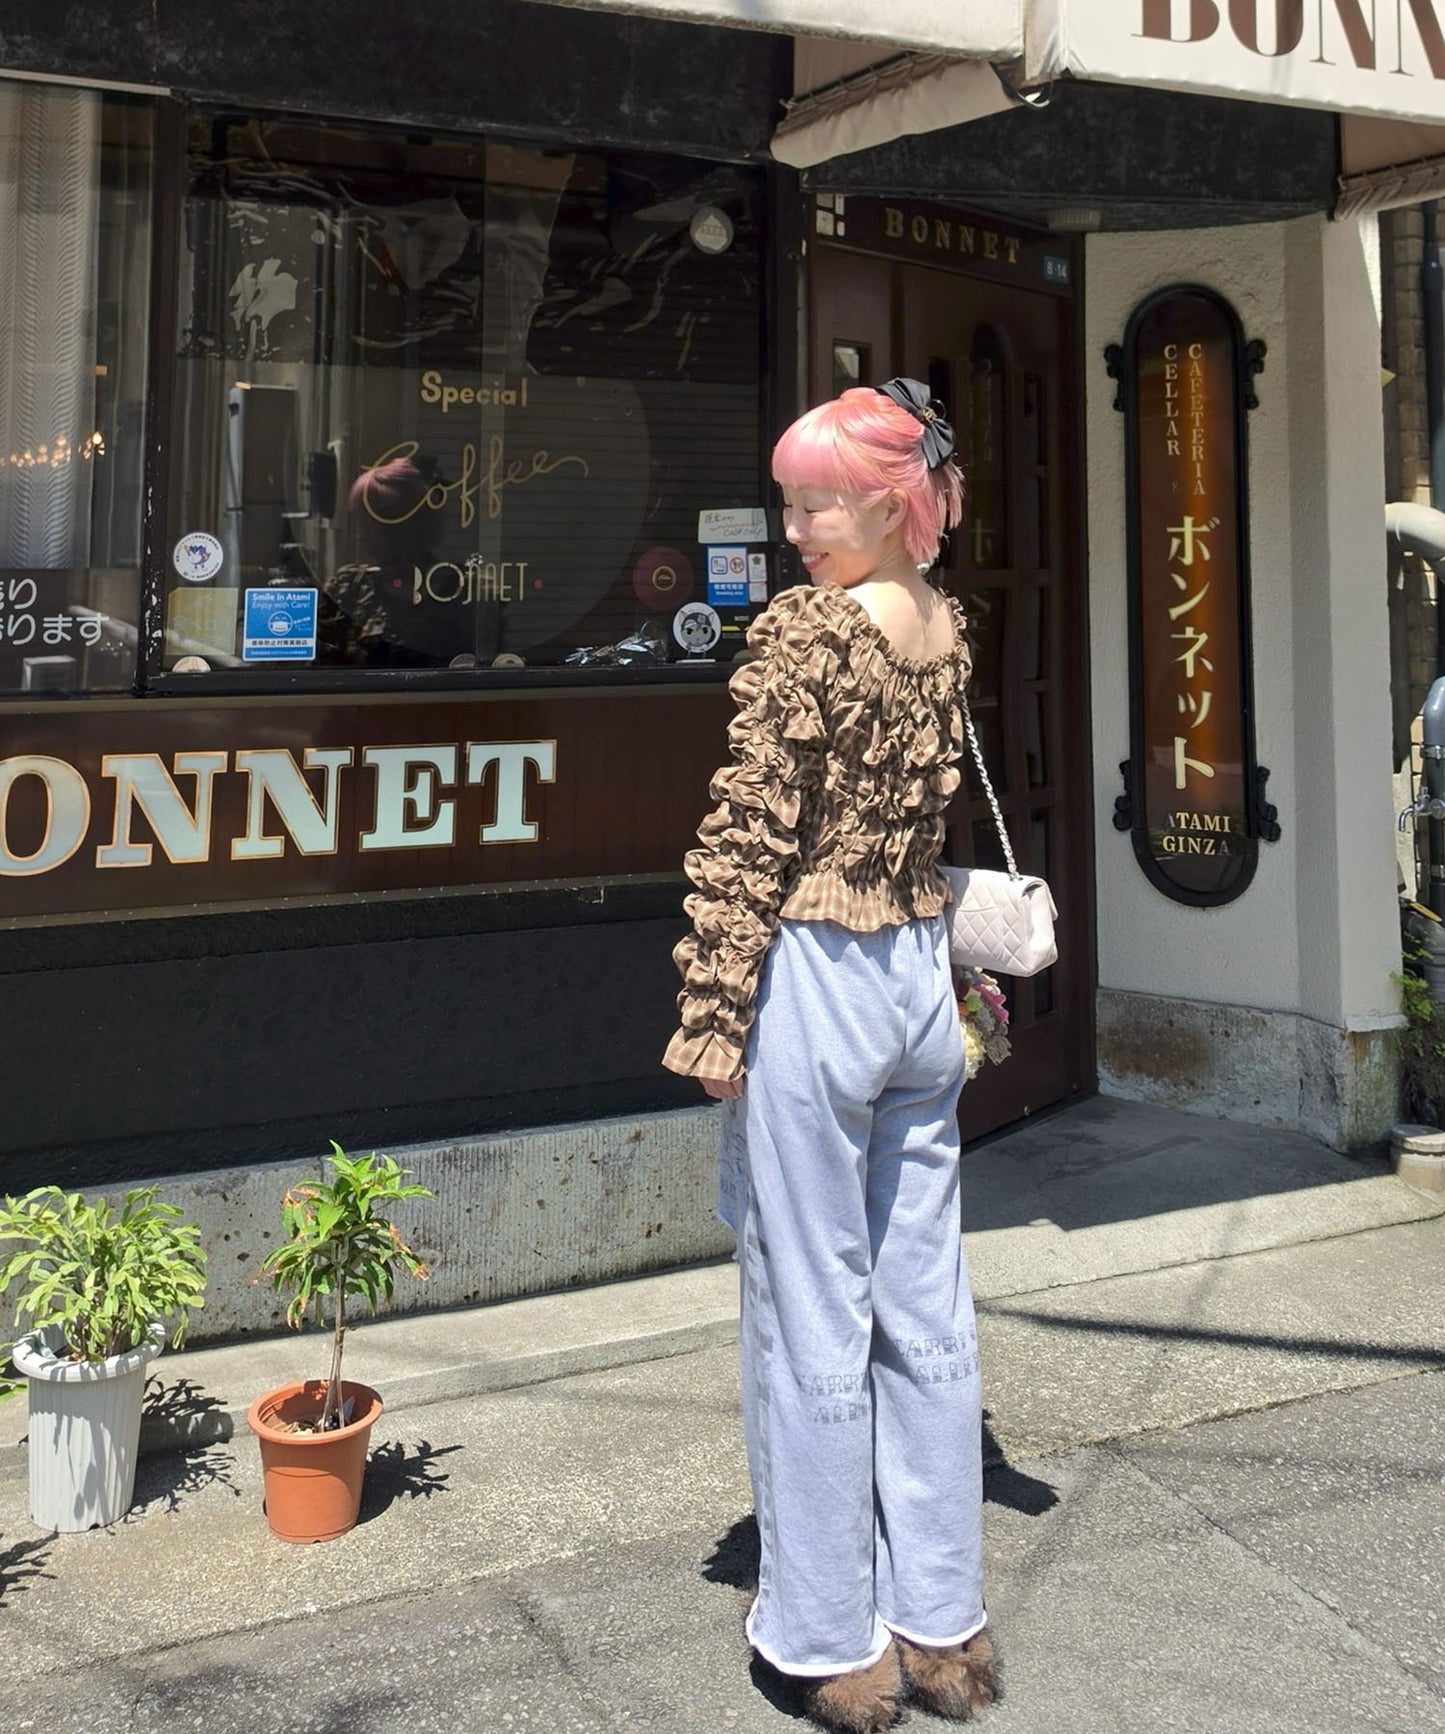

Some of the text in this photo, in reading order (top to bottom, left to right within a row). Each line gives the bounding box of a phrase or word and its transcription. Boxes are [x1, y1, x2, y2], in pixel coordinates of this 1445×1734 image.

[885, 207, 1020, 264] BONNET
[420, 370, 528, 413] Special
[1163, 344, 1181, 456] CELLAR
[1187, 343, 1206, 495] CAFETERIA
[360, 435, 589, 528] Coffee
[252, 593, 311, 601] Smile in Atami
[252, 601, 272, 610] Enjoy
[274, 601, 290, 609] with
[412, 562, 529, 606] BONNET
[1166, 516, 1220, 790] ボンネット
[1164, 812, 1231, 834] ATAMI
[1162, 835, 1232, 856] GINZA
